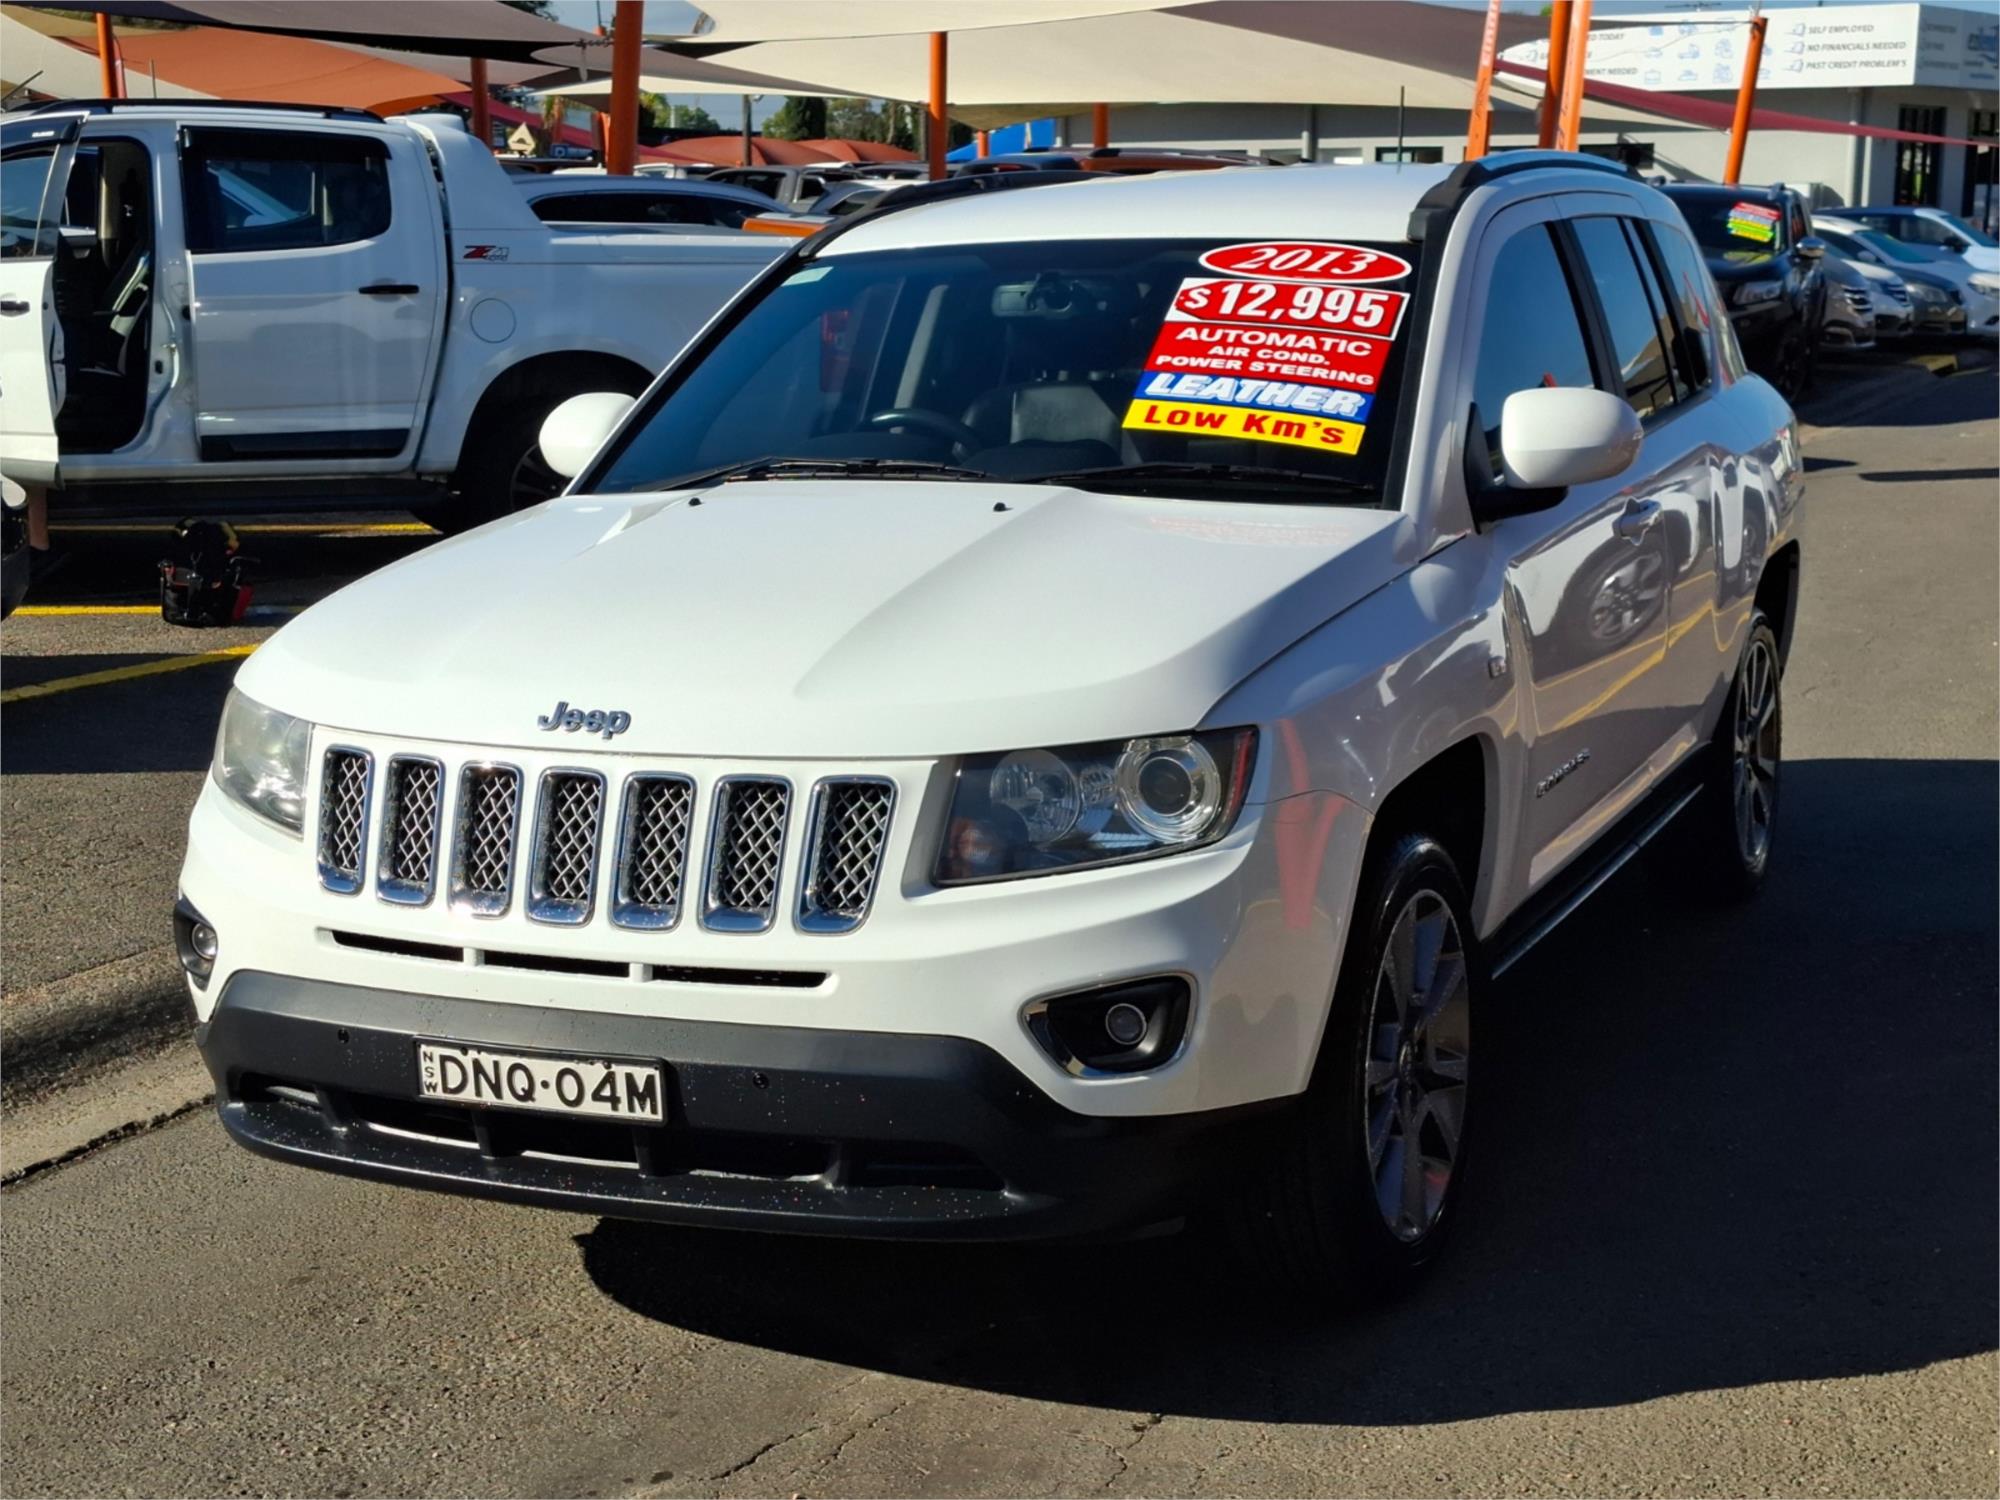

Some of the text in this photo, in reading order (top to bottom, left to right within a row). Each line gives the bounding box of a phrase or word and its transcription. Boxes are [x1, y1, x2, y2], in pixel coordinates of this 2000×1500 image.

[1808, 24, 1875, 34] SELF EMPLOYED
[1807, 41, 1907, 52] NO FINANCIALS NEEDED
[1806, 62, 1827, 70] PAST
[1827, 61, 1858, 69] CREDIT
[1231, 248, 1378, 275] 2013
[1184, 283, 1389, 327] $12,995
[1176, 327, 1372, 356] AUTOMATIC
[1207, 345, 1331, 366] AIR COND.
[1155, 354, 1375, 386] POWER STEERING
[1145, 373, 1365, 415] LEATHER
[537, 700, 632, 740] Jeep
